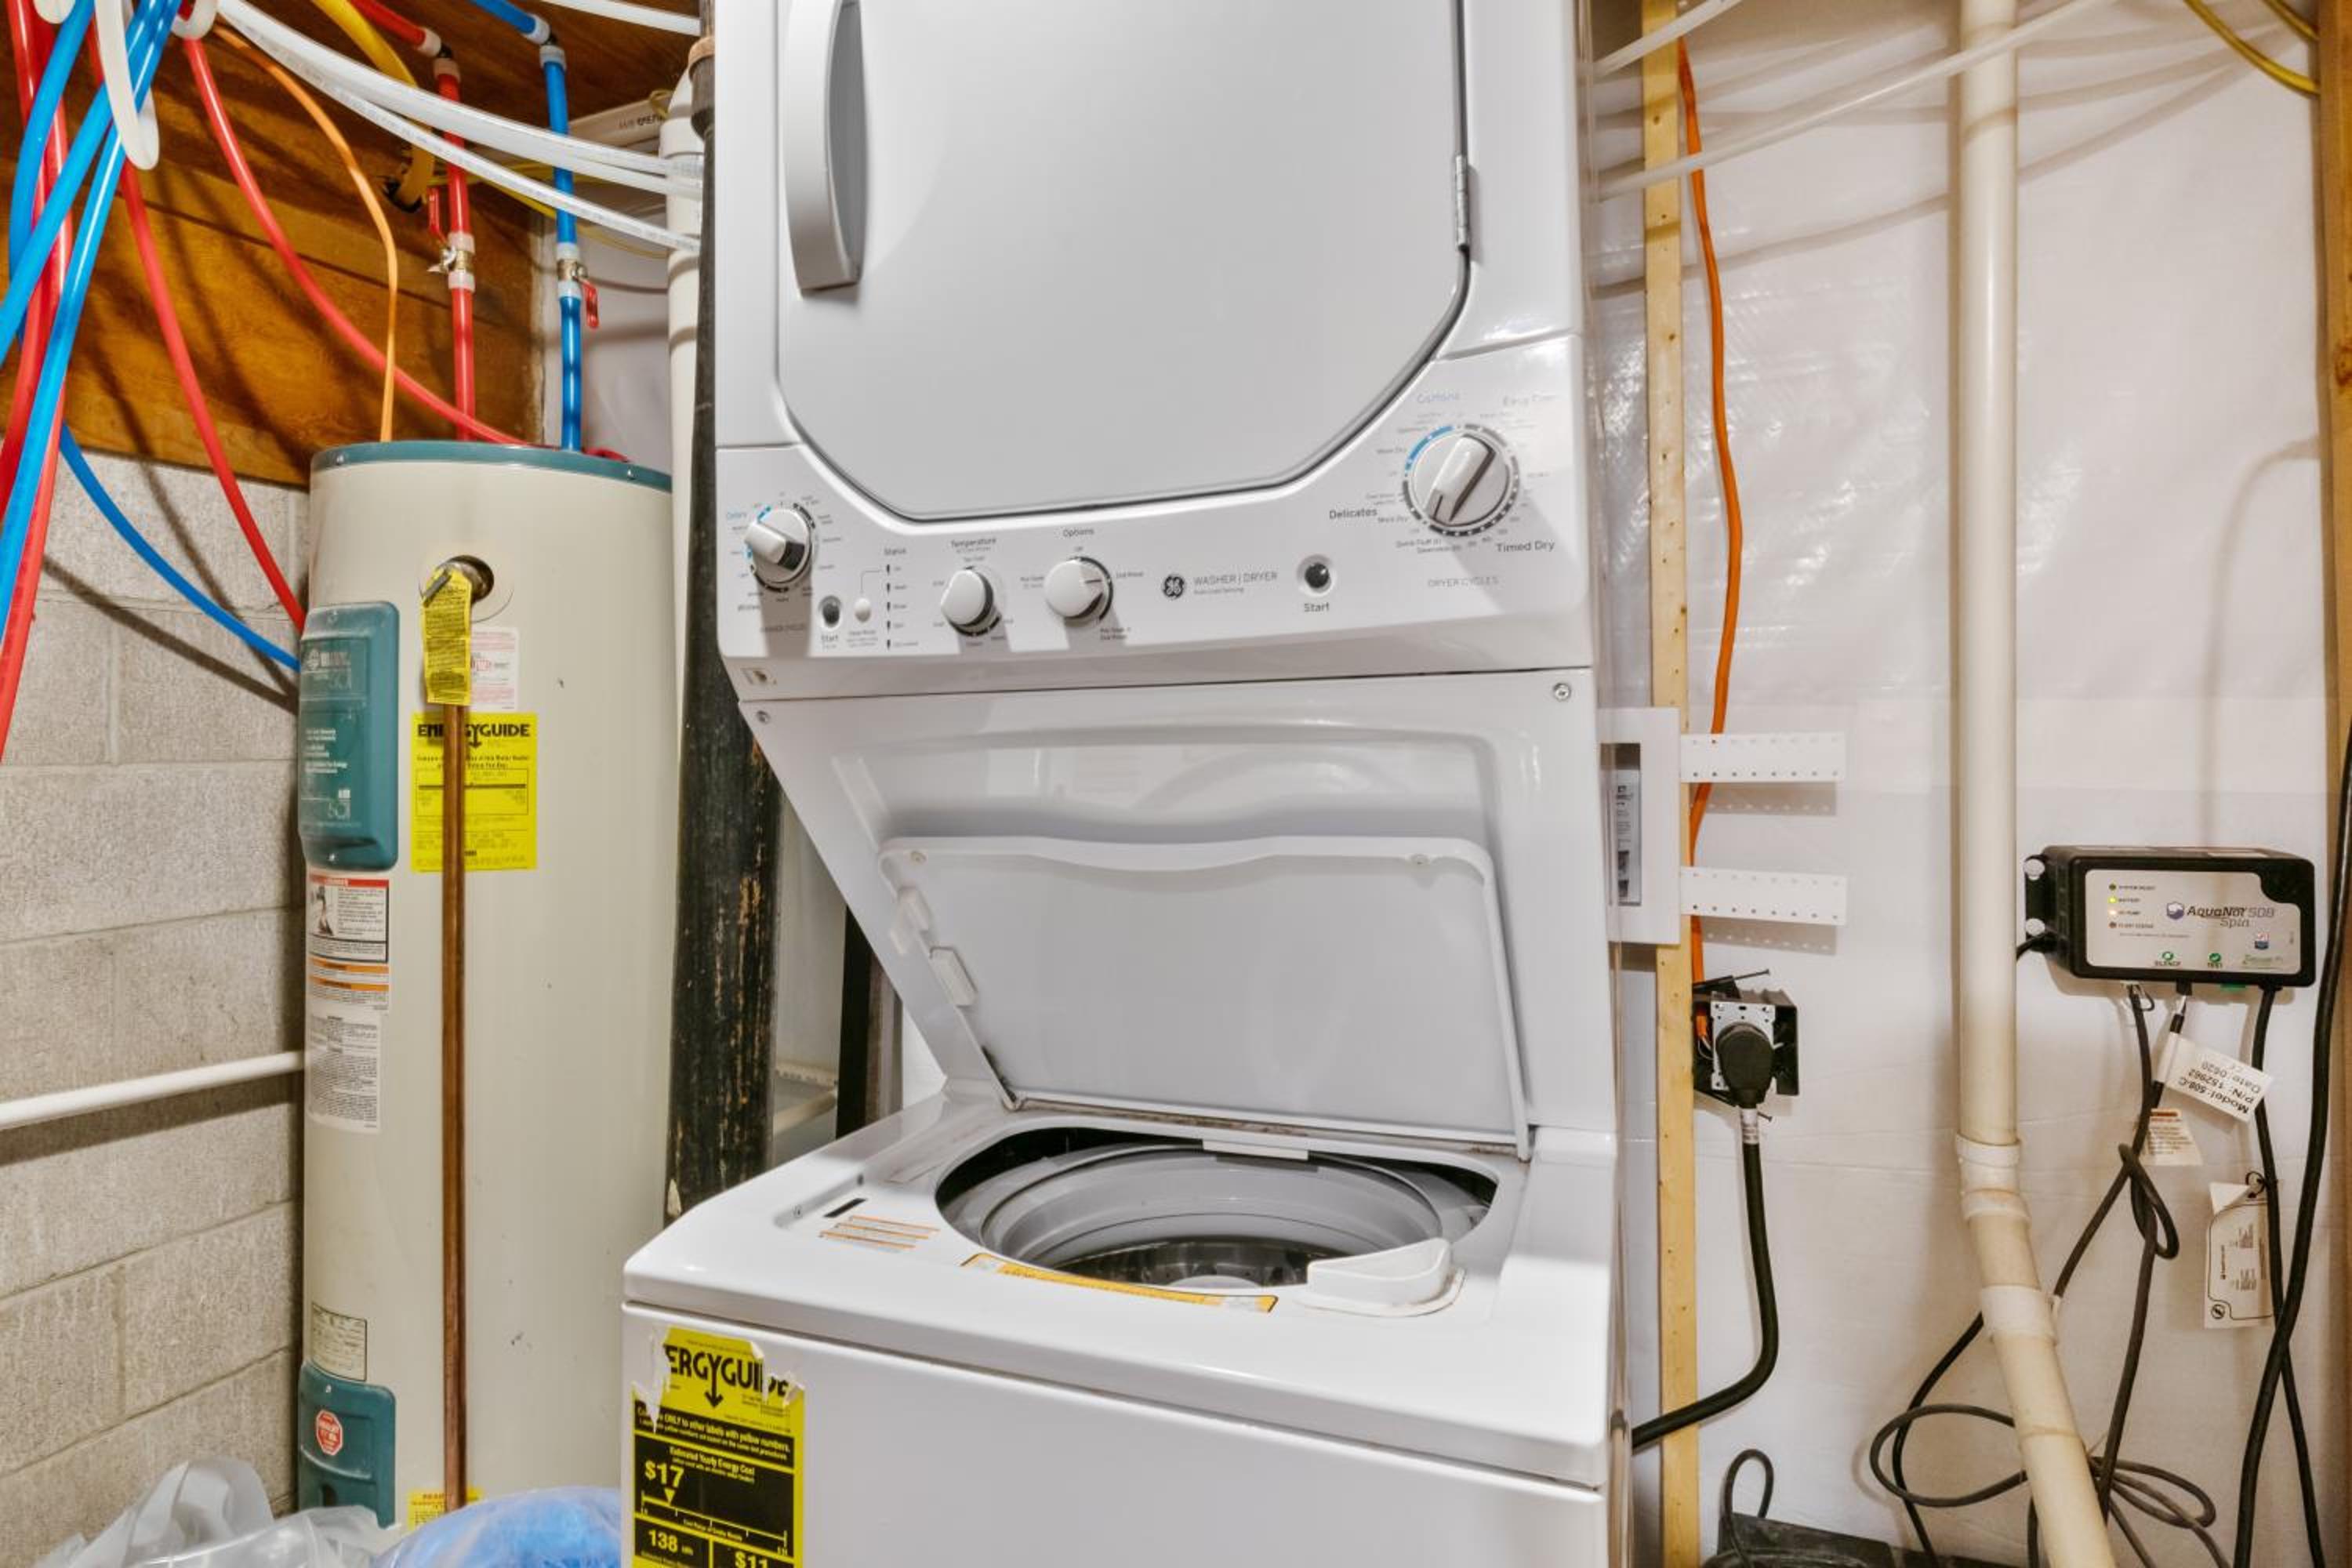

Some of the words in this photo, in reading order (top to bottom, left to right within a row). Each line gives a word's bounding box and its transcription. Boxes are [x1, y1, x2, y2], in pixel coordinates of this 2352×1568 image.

[1330, 508, 1377, 519] Delicates
[1063, 528, 1094, 539] Options
[951, 536, 996, 549] Temperature
[1496, 542, 1531, 553] Timed
[1534, 540, 1555, 552] Dry
[1193, 575, 1236, 586] WASHER
[1243, 572, 1279, 583] DRYER
[1304, 602, 1330, 612] Start
[2220, 917, 2249, 928] Spin
[2208, 1091, 2249, 1114] Model:
[645, 1460, 684, 1488] $17
[648, 1530, 678, 1553] 138
